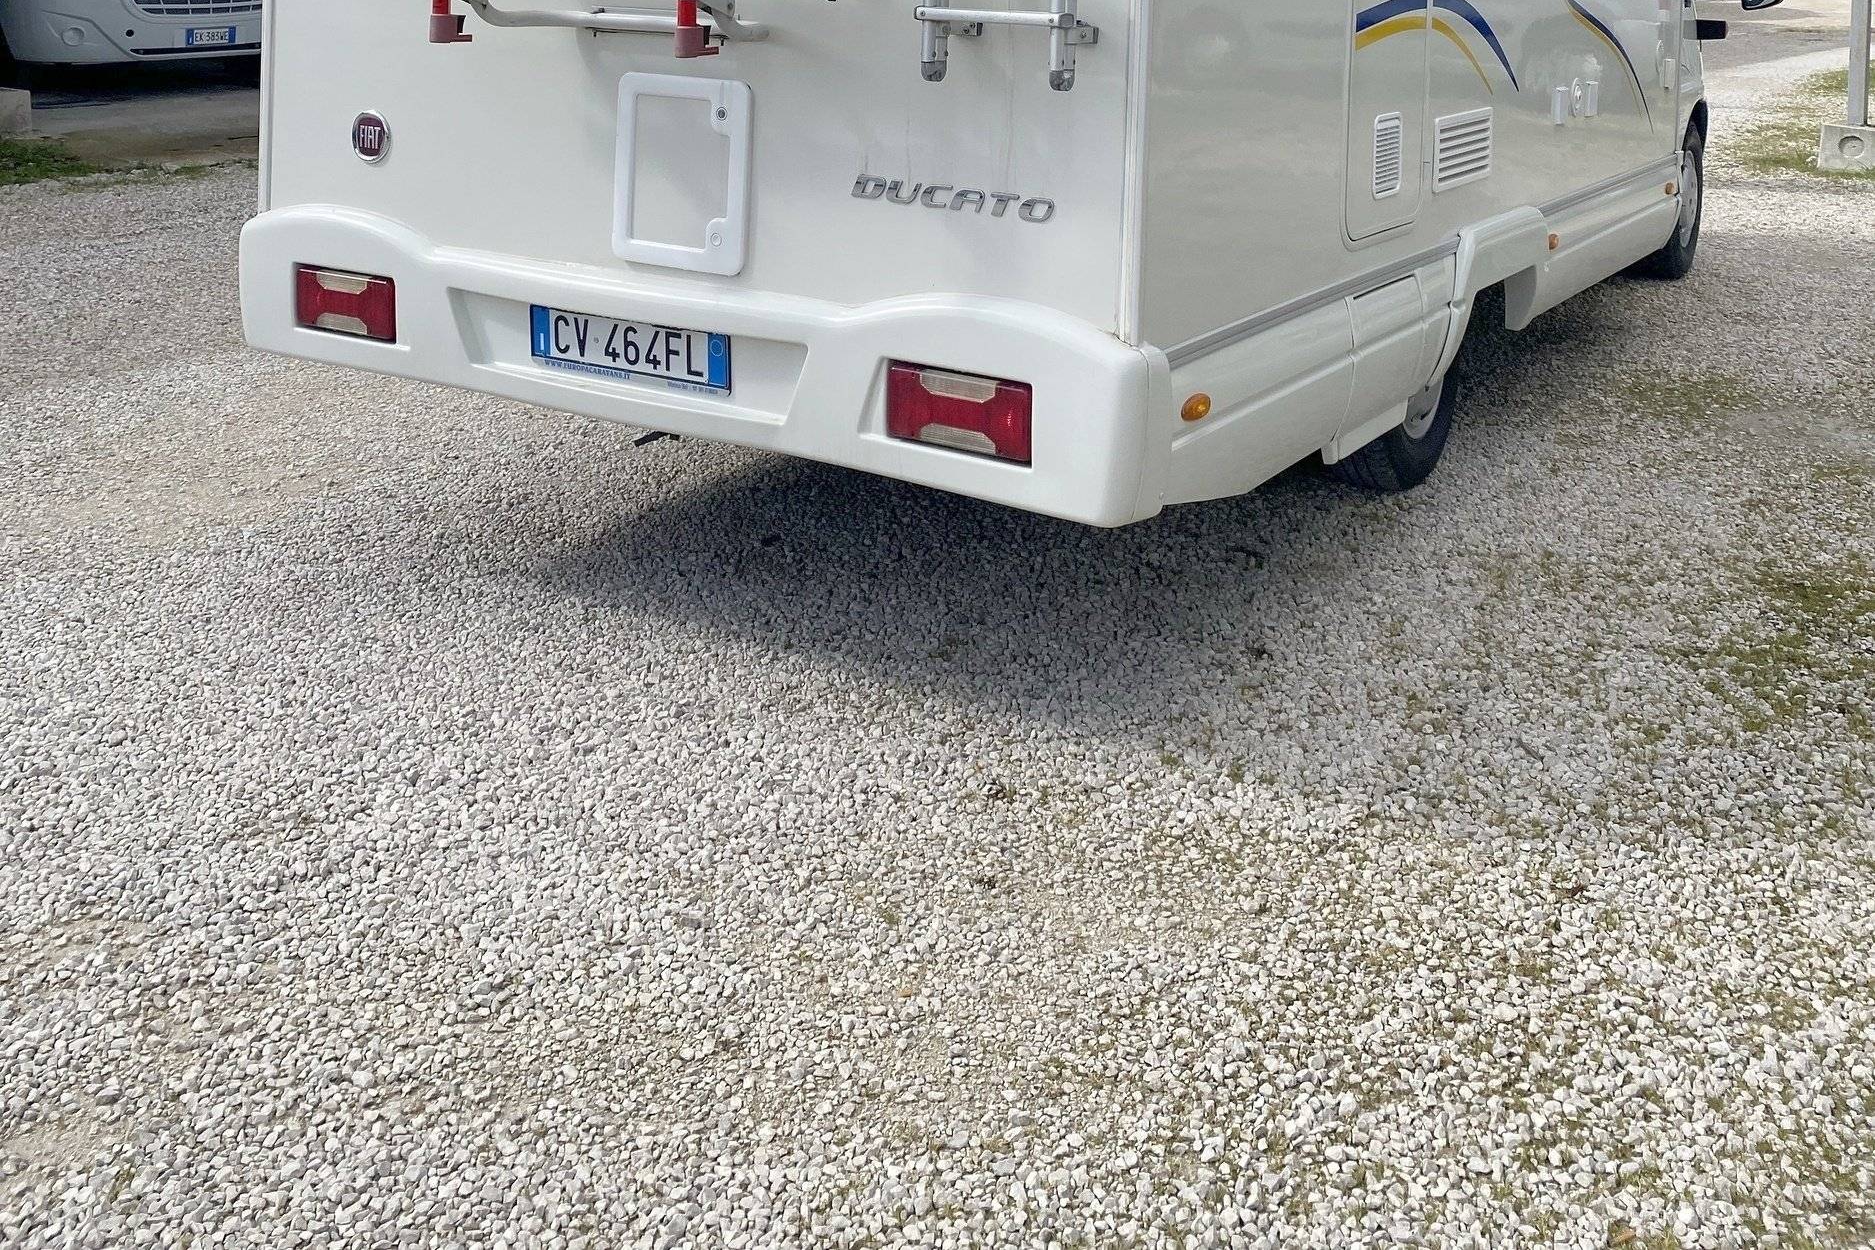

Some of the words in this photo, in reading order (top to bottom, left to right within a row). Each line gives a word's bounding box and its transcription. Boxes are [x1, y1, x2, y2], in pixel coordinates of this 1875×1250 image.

[359, 124, 381, 149] FIAT
[850, 173, 1055, 223] DUCATO
[553, 314, 590, 358] CV
[603, 322, 705, 378] 464FL
